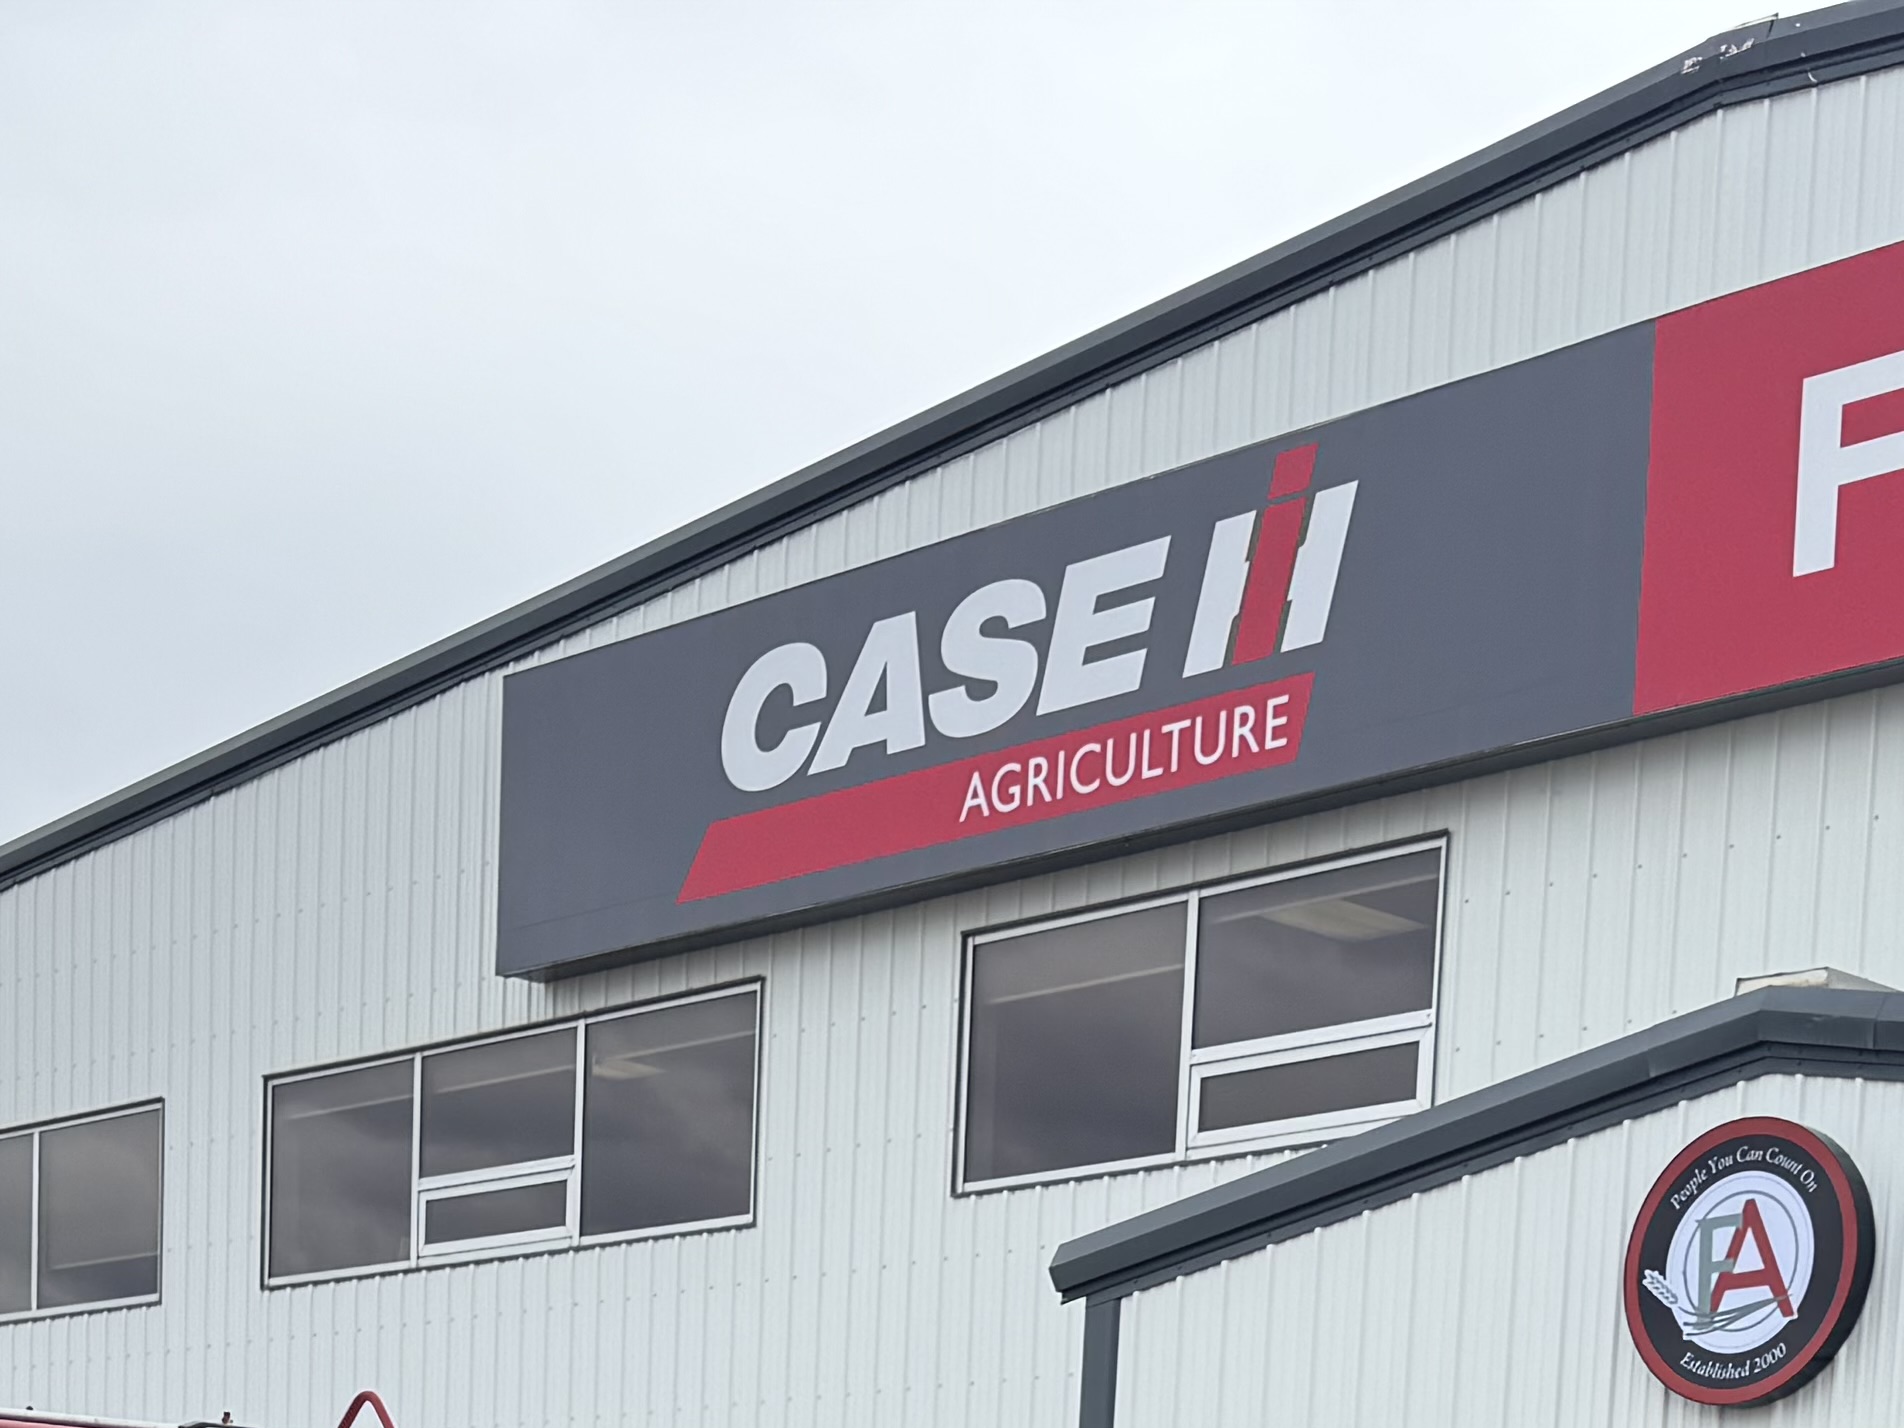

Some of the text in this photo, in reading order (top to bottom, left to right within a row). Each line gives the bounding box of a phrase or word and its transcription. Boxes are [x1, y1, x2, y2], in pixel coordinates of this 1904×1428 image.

[720, 534, 1172, 793] CASE
[958, 694, 1290, 823] AGRICULTURE
[1669, 1145, 1820, 1211] People You Can Count On
[1679, 1342, 1787, 1380] Established 2000
